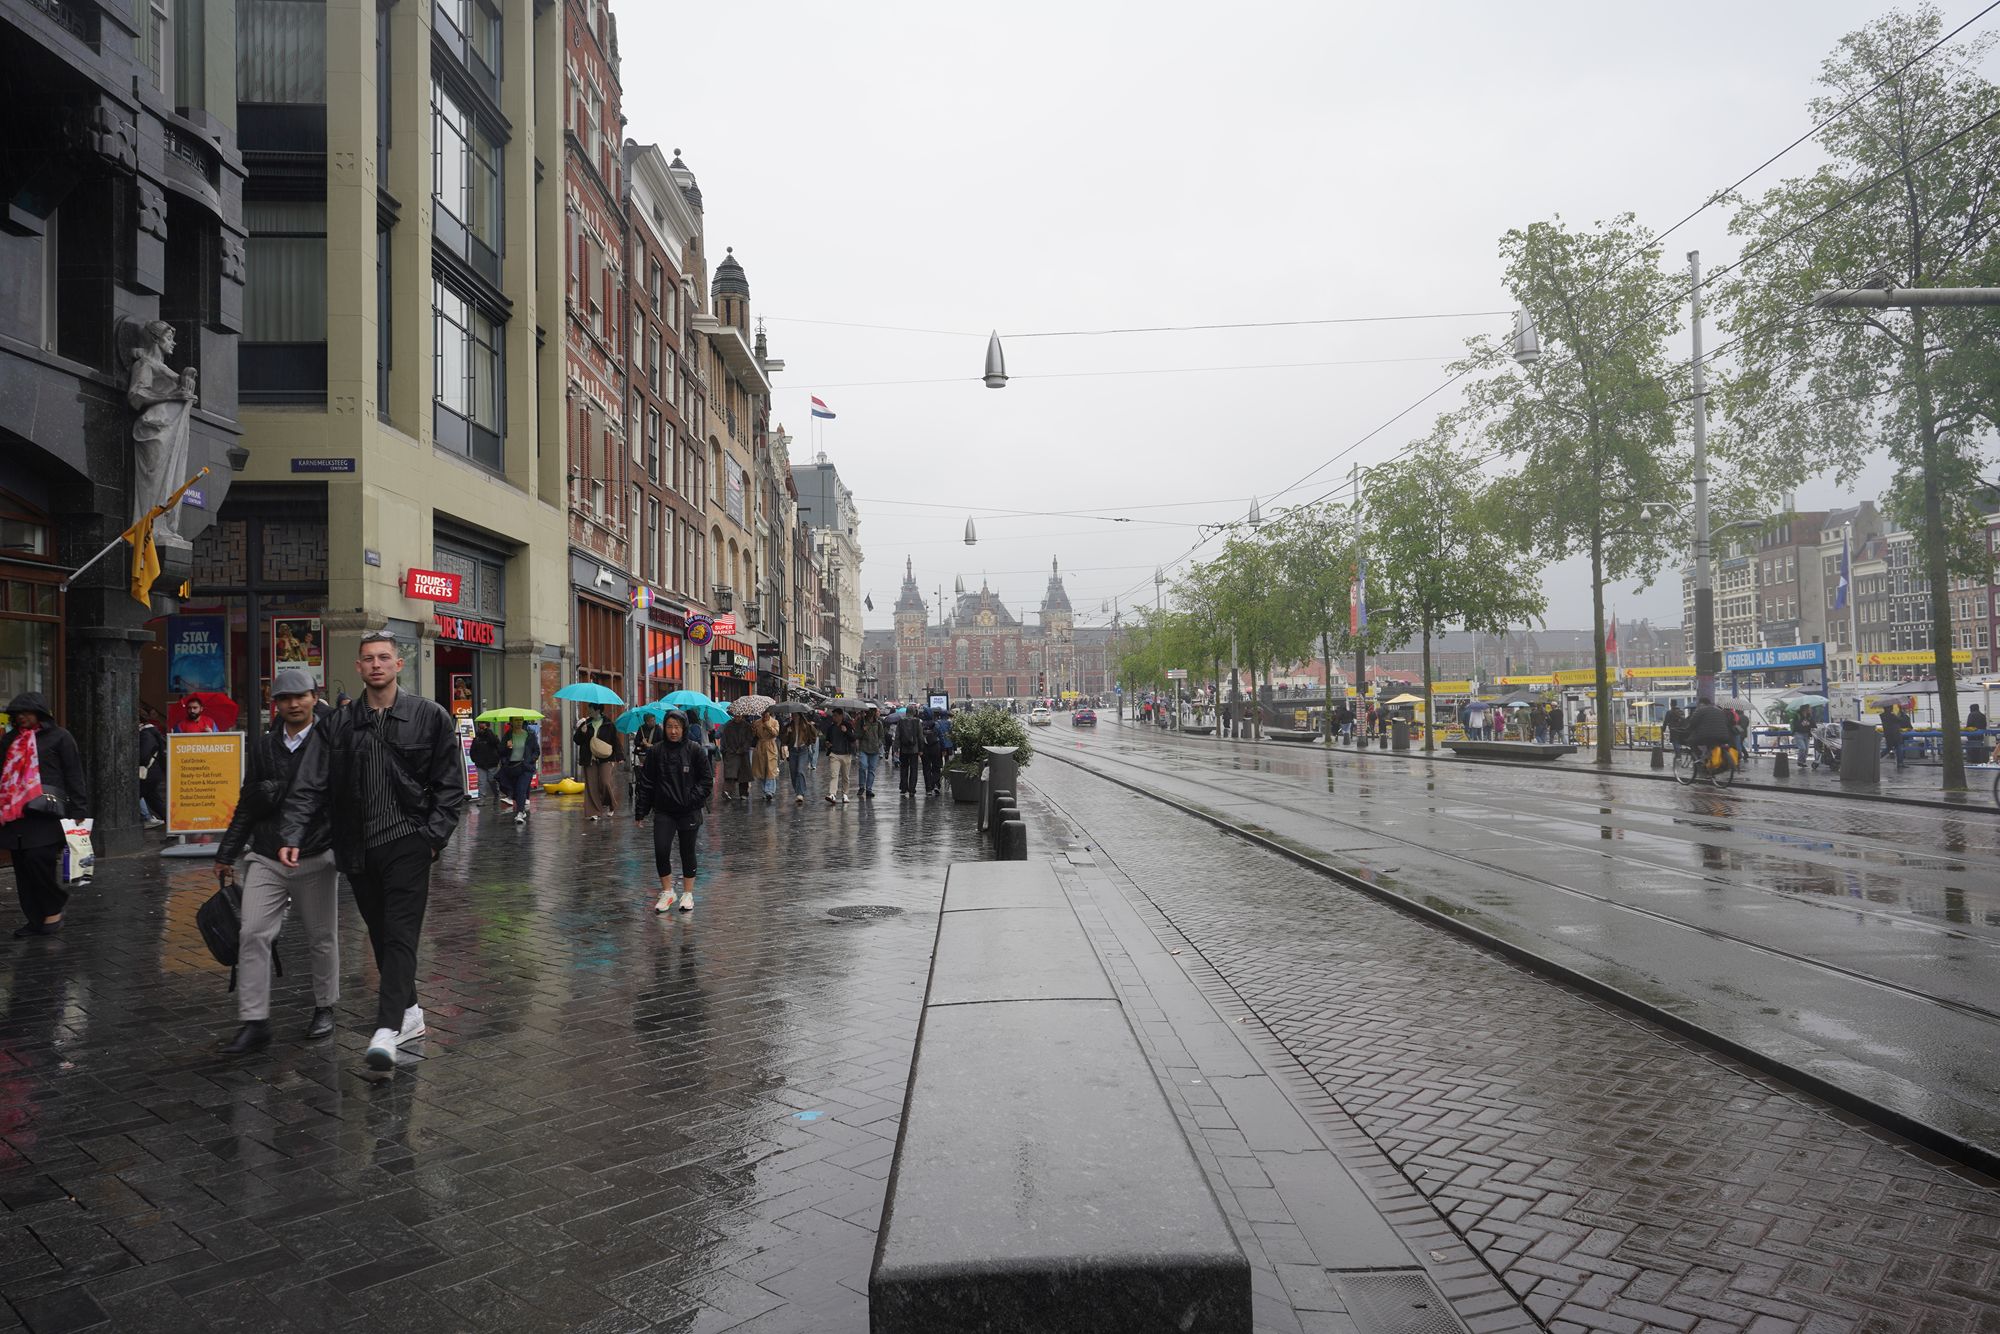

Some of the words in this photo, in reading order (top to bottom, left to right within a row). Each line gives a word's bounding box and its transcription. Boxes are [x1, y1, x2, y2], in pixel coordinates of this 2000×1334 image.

[414, 583, 452, 597] TICKETS
[182, 631, 209, 642] STAY
[174, 642, 218, 654] FROSTY
[1727, 652, 1755, 667] REDERIJ
[1756, 651, 1775, 666] PLAS
[176, 744, 234, 753] SUPERMARKET
